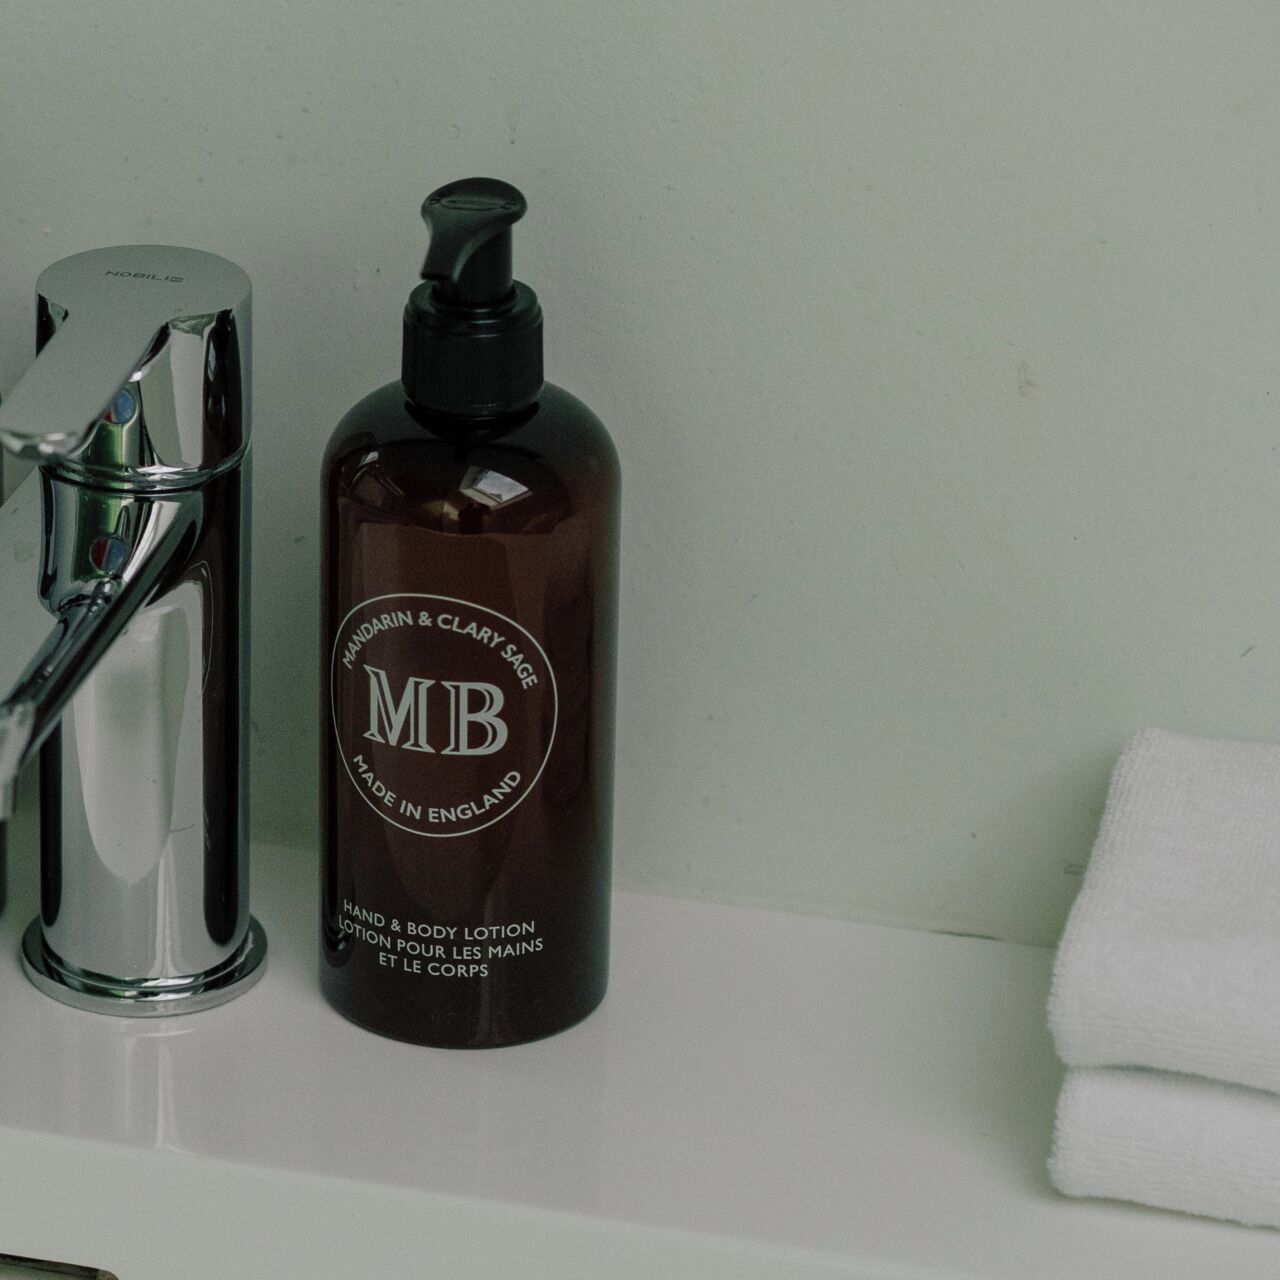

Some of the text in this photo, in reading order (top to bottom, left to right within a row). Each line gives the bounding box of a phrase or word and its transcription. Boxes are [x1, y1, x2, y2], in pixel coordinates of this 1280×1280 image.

[342, 610, 538, 690] MANDARIN & CLARY SAGE
[363, 664, 509, 756] MB
[353, 754, 521, 823] MADE IN ENGLAND
[338, 914, 544, 960] LOTION POUR LES MAINS
[343, 898, 535, 940] HAND & BODY LOTION
[379, 951, 489, 978] ET LE CORPS
